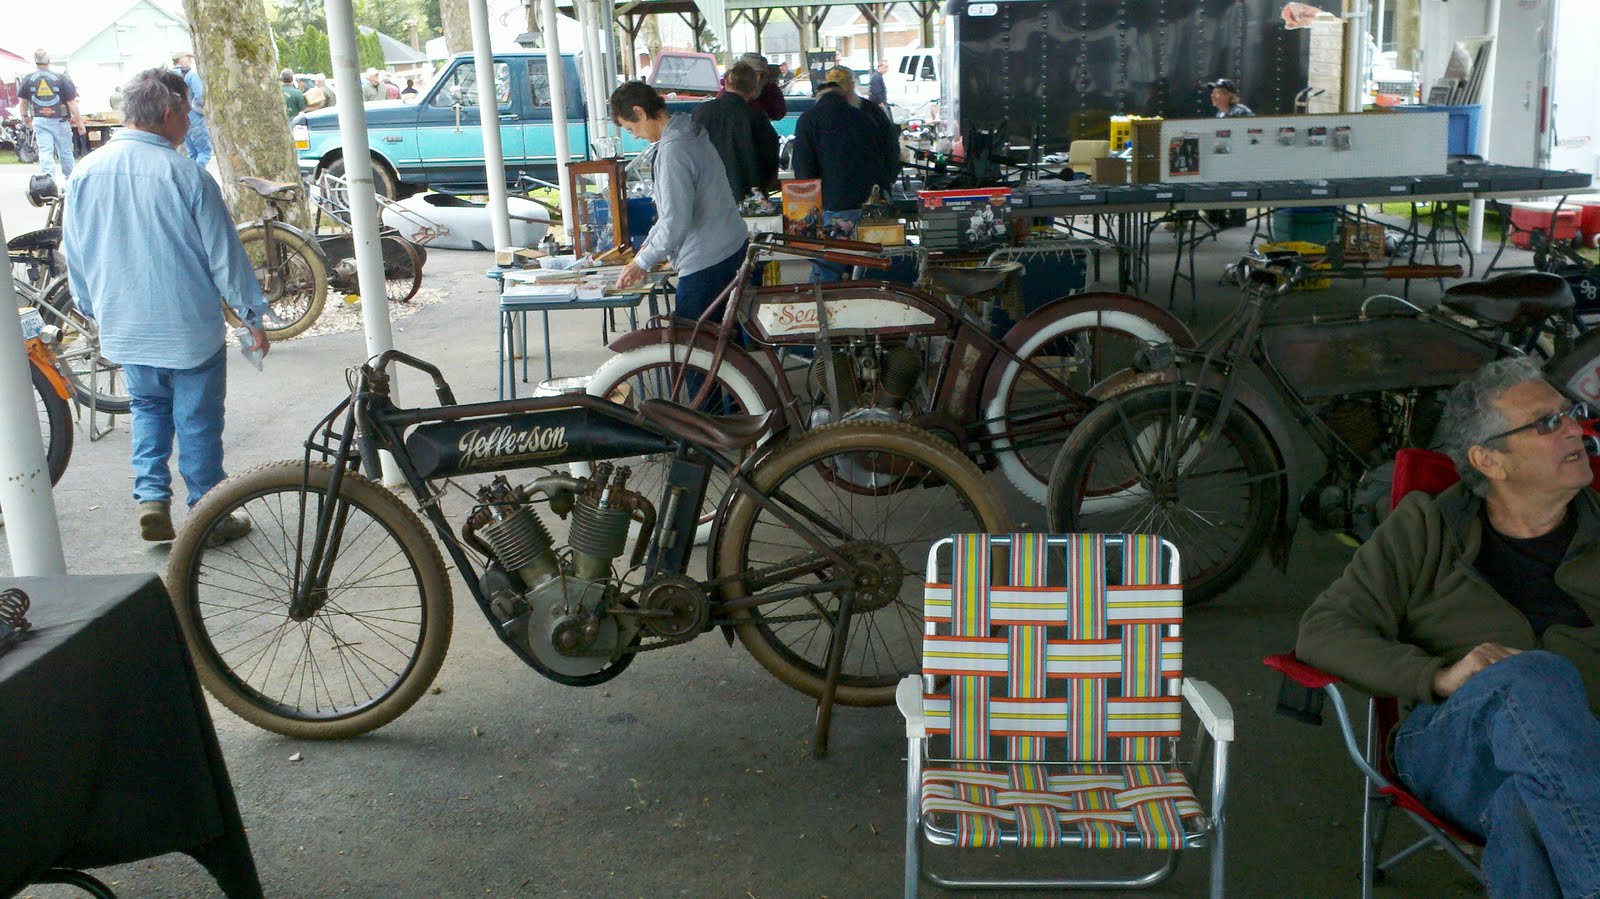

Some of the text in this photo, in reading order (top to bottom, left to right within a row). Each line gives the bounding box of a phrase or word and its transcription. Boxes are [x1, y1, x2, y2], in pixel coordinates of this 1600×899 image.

[1580, 279, 1597, 300] 98
[778, 304, 834, 325] Seas
[459, 425, 568, 471] Jefferson
